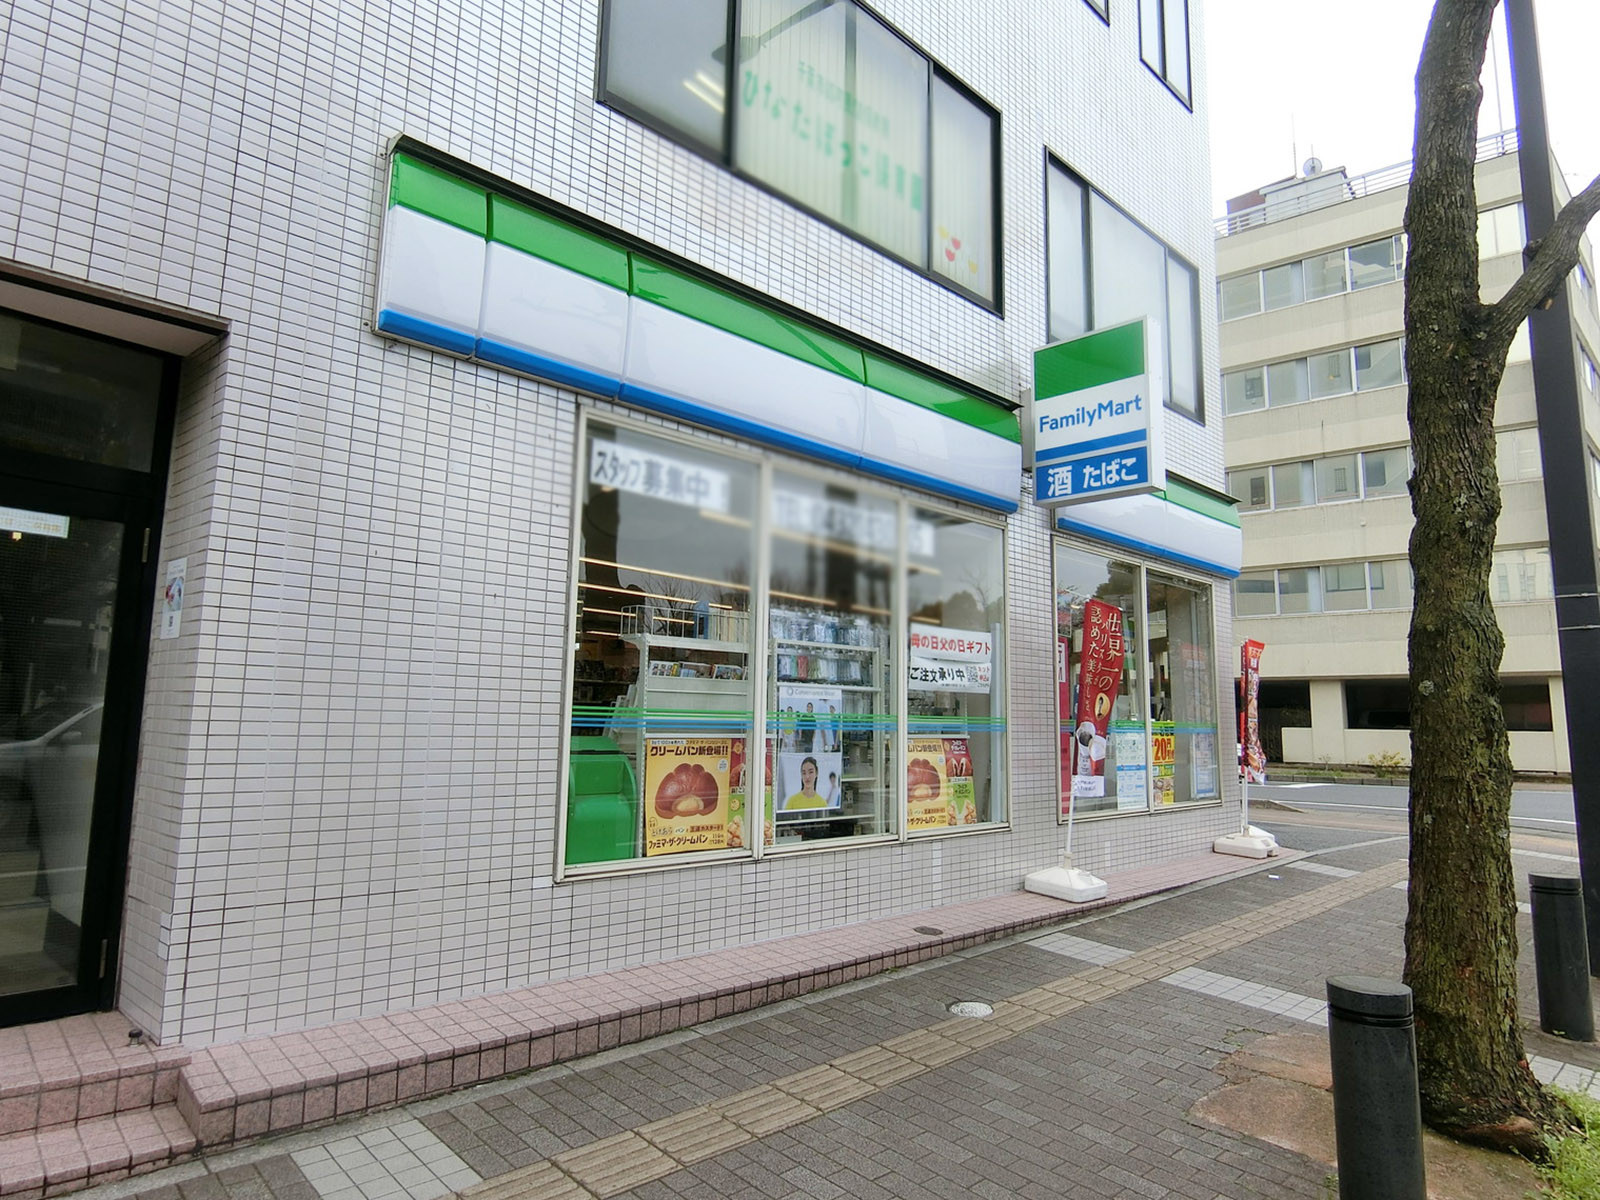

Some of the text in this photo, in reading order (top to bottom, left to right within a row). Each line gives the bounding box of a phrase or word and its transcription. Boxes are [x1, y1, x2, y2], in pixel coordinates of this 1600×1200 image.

[1039, 394, 1142, 433] FamilyMart
[1047, 457, 1138, 497] 酒 たばこ
[911, 633, 991, 655] 母の日父の日ギフト
[1098, 613, 1123, 691] 世界一の
[910, 667, 966, 683] ご注文承り中
[648, 834, 708, 849] ファミマ・ザ・クリームパン
